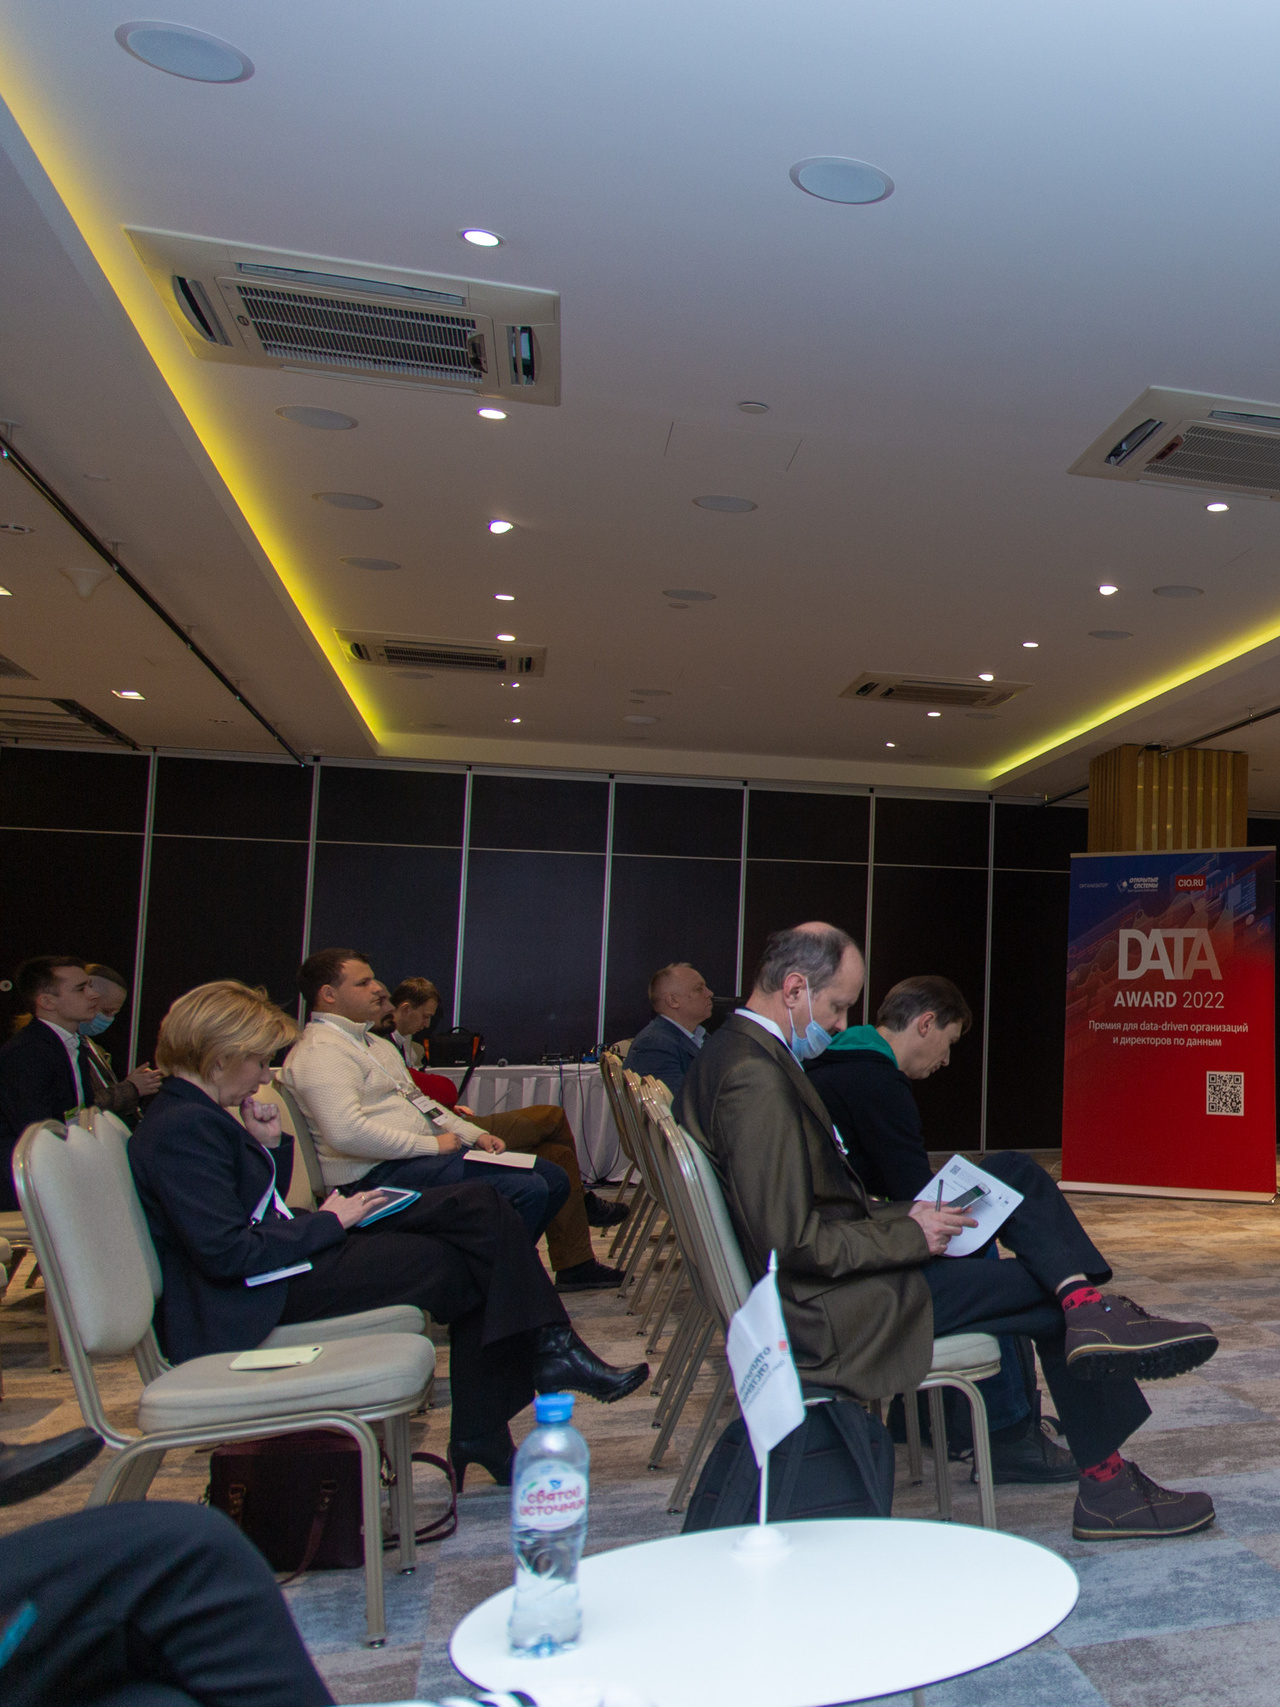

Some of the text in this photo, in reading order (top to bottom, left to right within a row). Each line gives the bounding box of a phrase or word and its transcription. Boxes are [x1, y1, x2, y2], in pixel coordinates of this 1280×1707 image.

[1177, 879, 1204, 888] CIO.RU
[1118, 928, 1223, 980] DATA
[1113, 991, 1225, 1009] AWARD 2022
[1088, 1020, 1249, 1034] Премия для data-driven организаций
[1113, 1036, 1222, 1047] и директоров по данным
